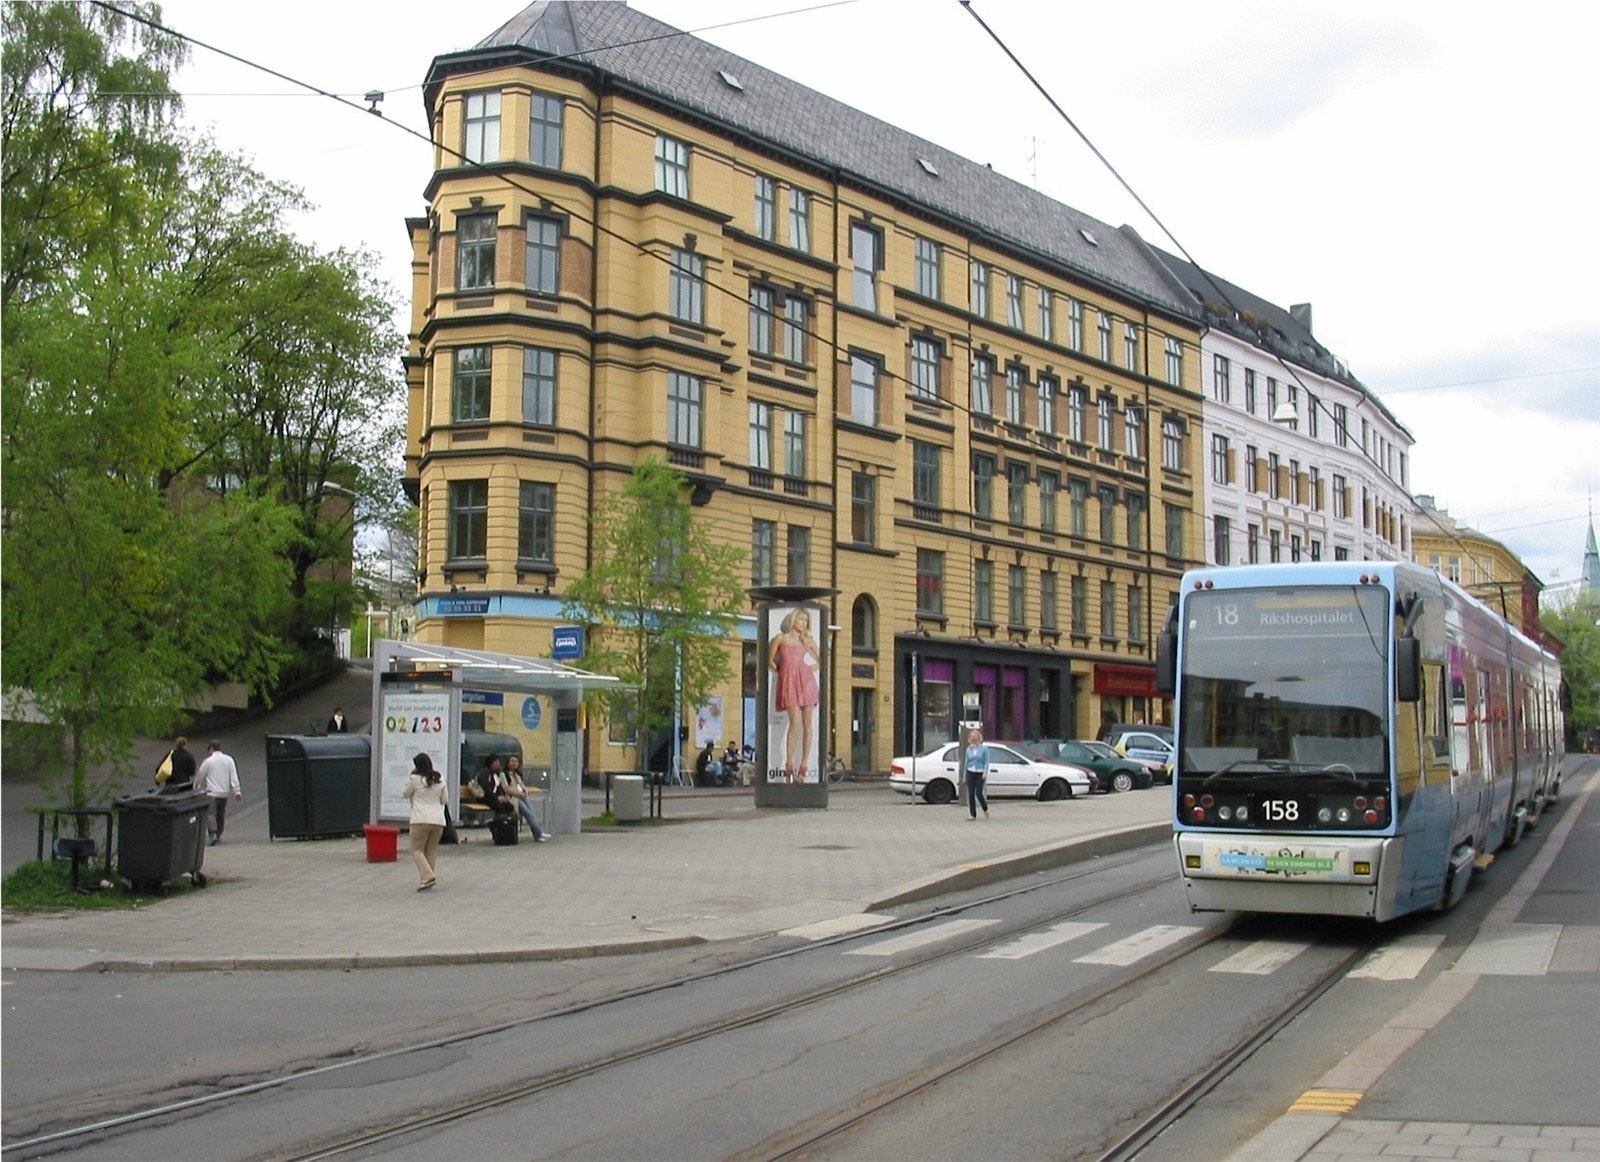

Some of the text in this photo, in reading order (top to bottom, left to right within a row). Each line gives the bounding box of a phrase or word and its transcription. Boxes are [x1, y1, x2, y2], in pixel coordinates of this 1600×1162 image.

[1214, 604, 1239, 625] 18
[1260, 611, 1354, 626] Rikshospitalet
[527, 702, 535, 718] 5
[386, 716, 442, 733] 02123
[1262, 800, 1299, 821] 158
